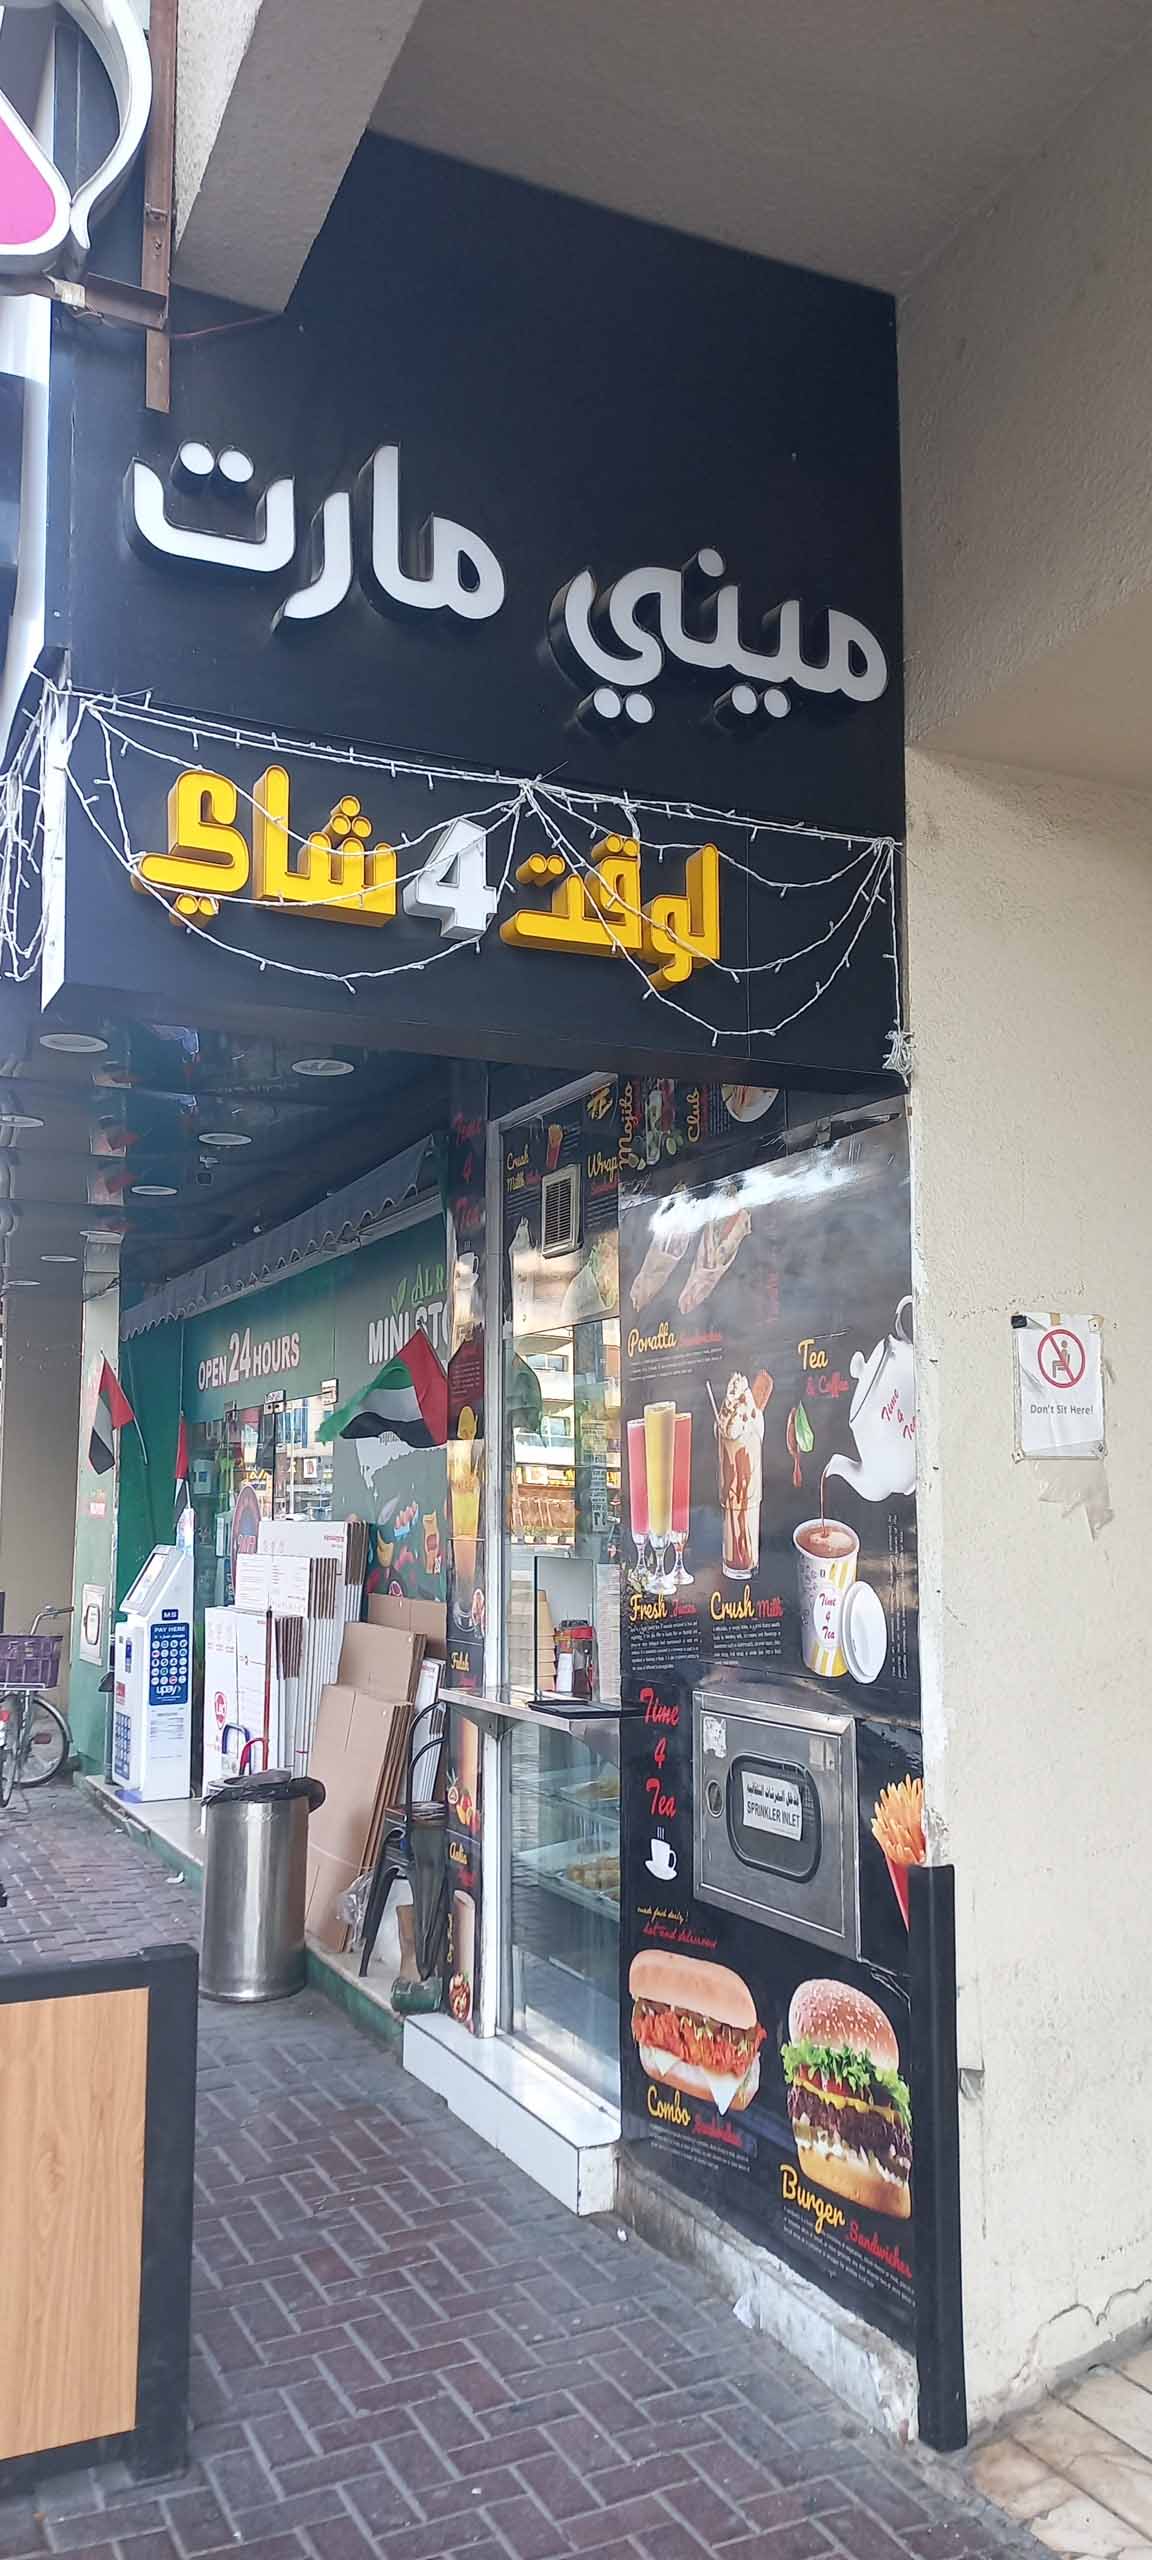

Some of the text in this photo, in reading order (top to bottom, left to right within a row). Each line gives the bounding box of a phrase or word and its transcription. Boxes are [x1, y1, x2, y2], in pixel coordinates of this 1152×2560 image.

[132, 442, 888, 724] ميني مارت
[130, 764, 722, 984] لوقت 4 شاي
[687, 1087, 700, 1143] Club
[368, 1311, 411, 1365] MINI
[798, 1339, 828, 1370] Tea
[198, 1327, 300, 1391] OPEN 24 HOURS
[881, 1388, 899, 1422] Time
[1030, 1404, 1094, 1416] Don't Sit Here!
[629, 1591, 668, 1622] Fresh
[710, 1584, 784, 1621] Crush Milk
[819, 1593, 837, 1607] Time
[822, 1626, 836, 1640] Tea
[639, 1687, 680, 1728] Time
[654, 1737, 668, 1769] 4
[646, 1777, 677, 1820] Tea
[746, 1800, 801, 1829] SPRINKLER INLET
[647, 2085, 691, 2127] Combo
[780, 2163, 846, 2235] Burger
[846, 2220, 913, 2280] Sandwiches
